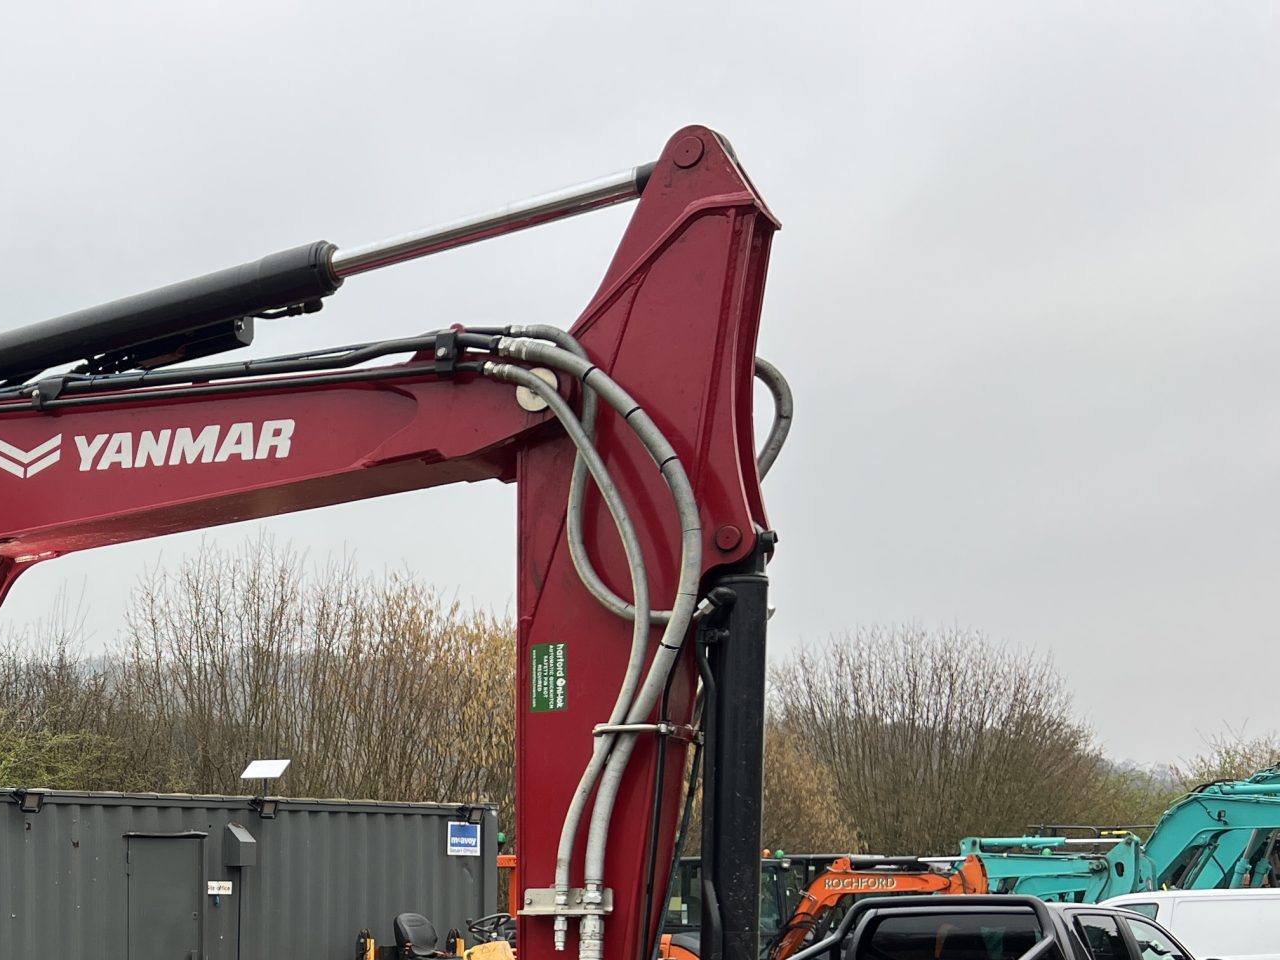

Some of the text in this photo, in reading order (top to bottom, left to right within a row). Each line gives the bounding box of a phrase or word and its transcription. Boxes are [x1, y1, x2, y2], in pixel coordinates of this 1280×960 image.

[74, 418, 295, 471] YANMAR
[556, 643, 564, 677] harford
[825, 877, 897, 890] ROCHFORD
